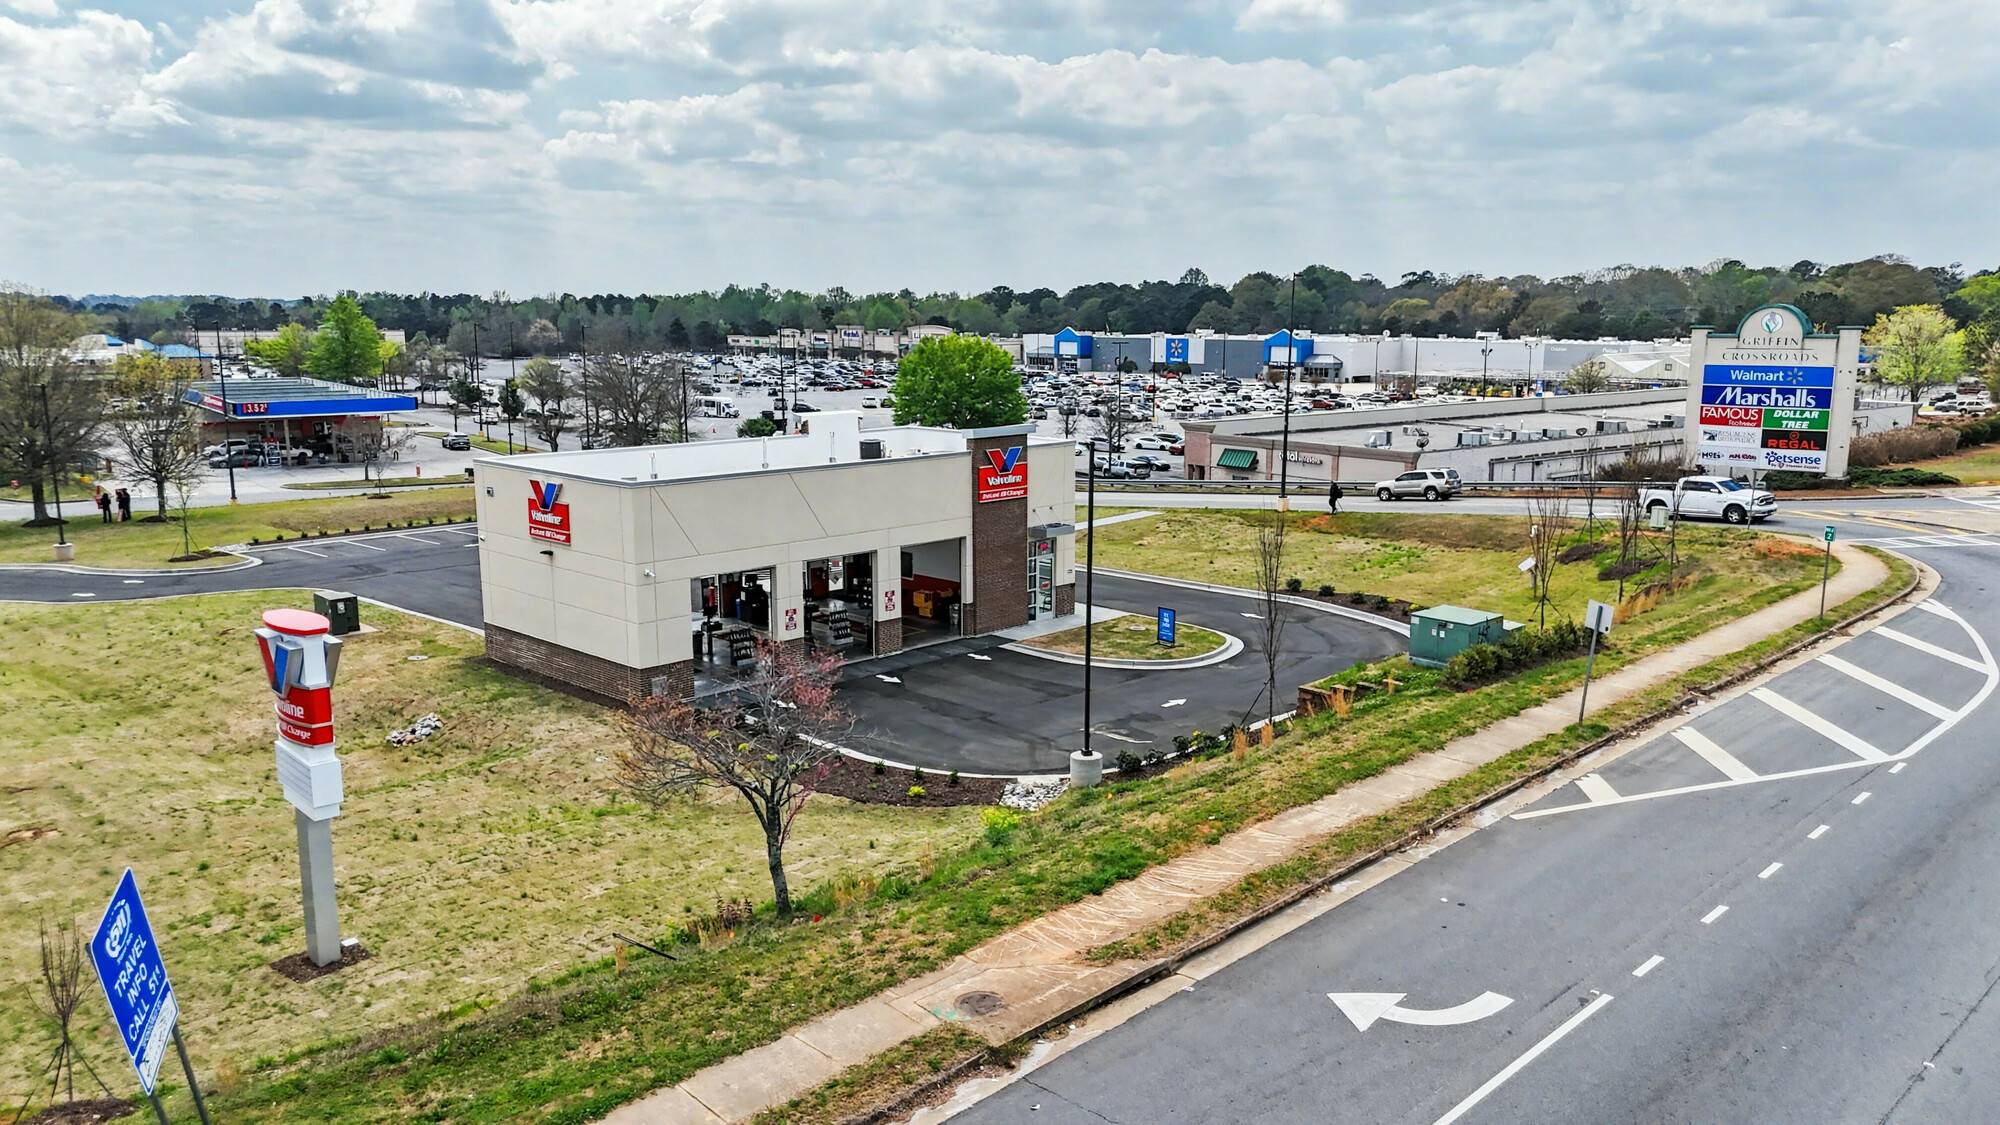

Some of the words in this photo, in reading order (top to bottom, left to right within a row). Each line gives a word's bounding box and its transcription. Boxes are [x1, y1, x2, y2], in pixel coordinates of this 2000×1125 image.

[1742, 337, 1799, 346] GRIFFIN
[1722, 352, 1819, 361] CROSSROADS
[1730, 369, 1784, 381] Walmart
[1715, 386, 1816, 408] Marshalls
[1702, 407, 1759, 421] FAMOUS
[1773, 410, 1819, 419] DOLLAR
[1781, 420, 1809, 429] TREE
[1767, 439, 1820, 450] REGAL
[1768, 454, 1821, 465] petsense
[114, 933, 147, 998] TRAVEL
[127, 962, 148, 1008] INFO
[128, 998, 150, 1042] CALL
